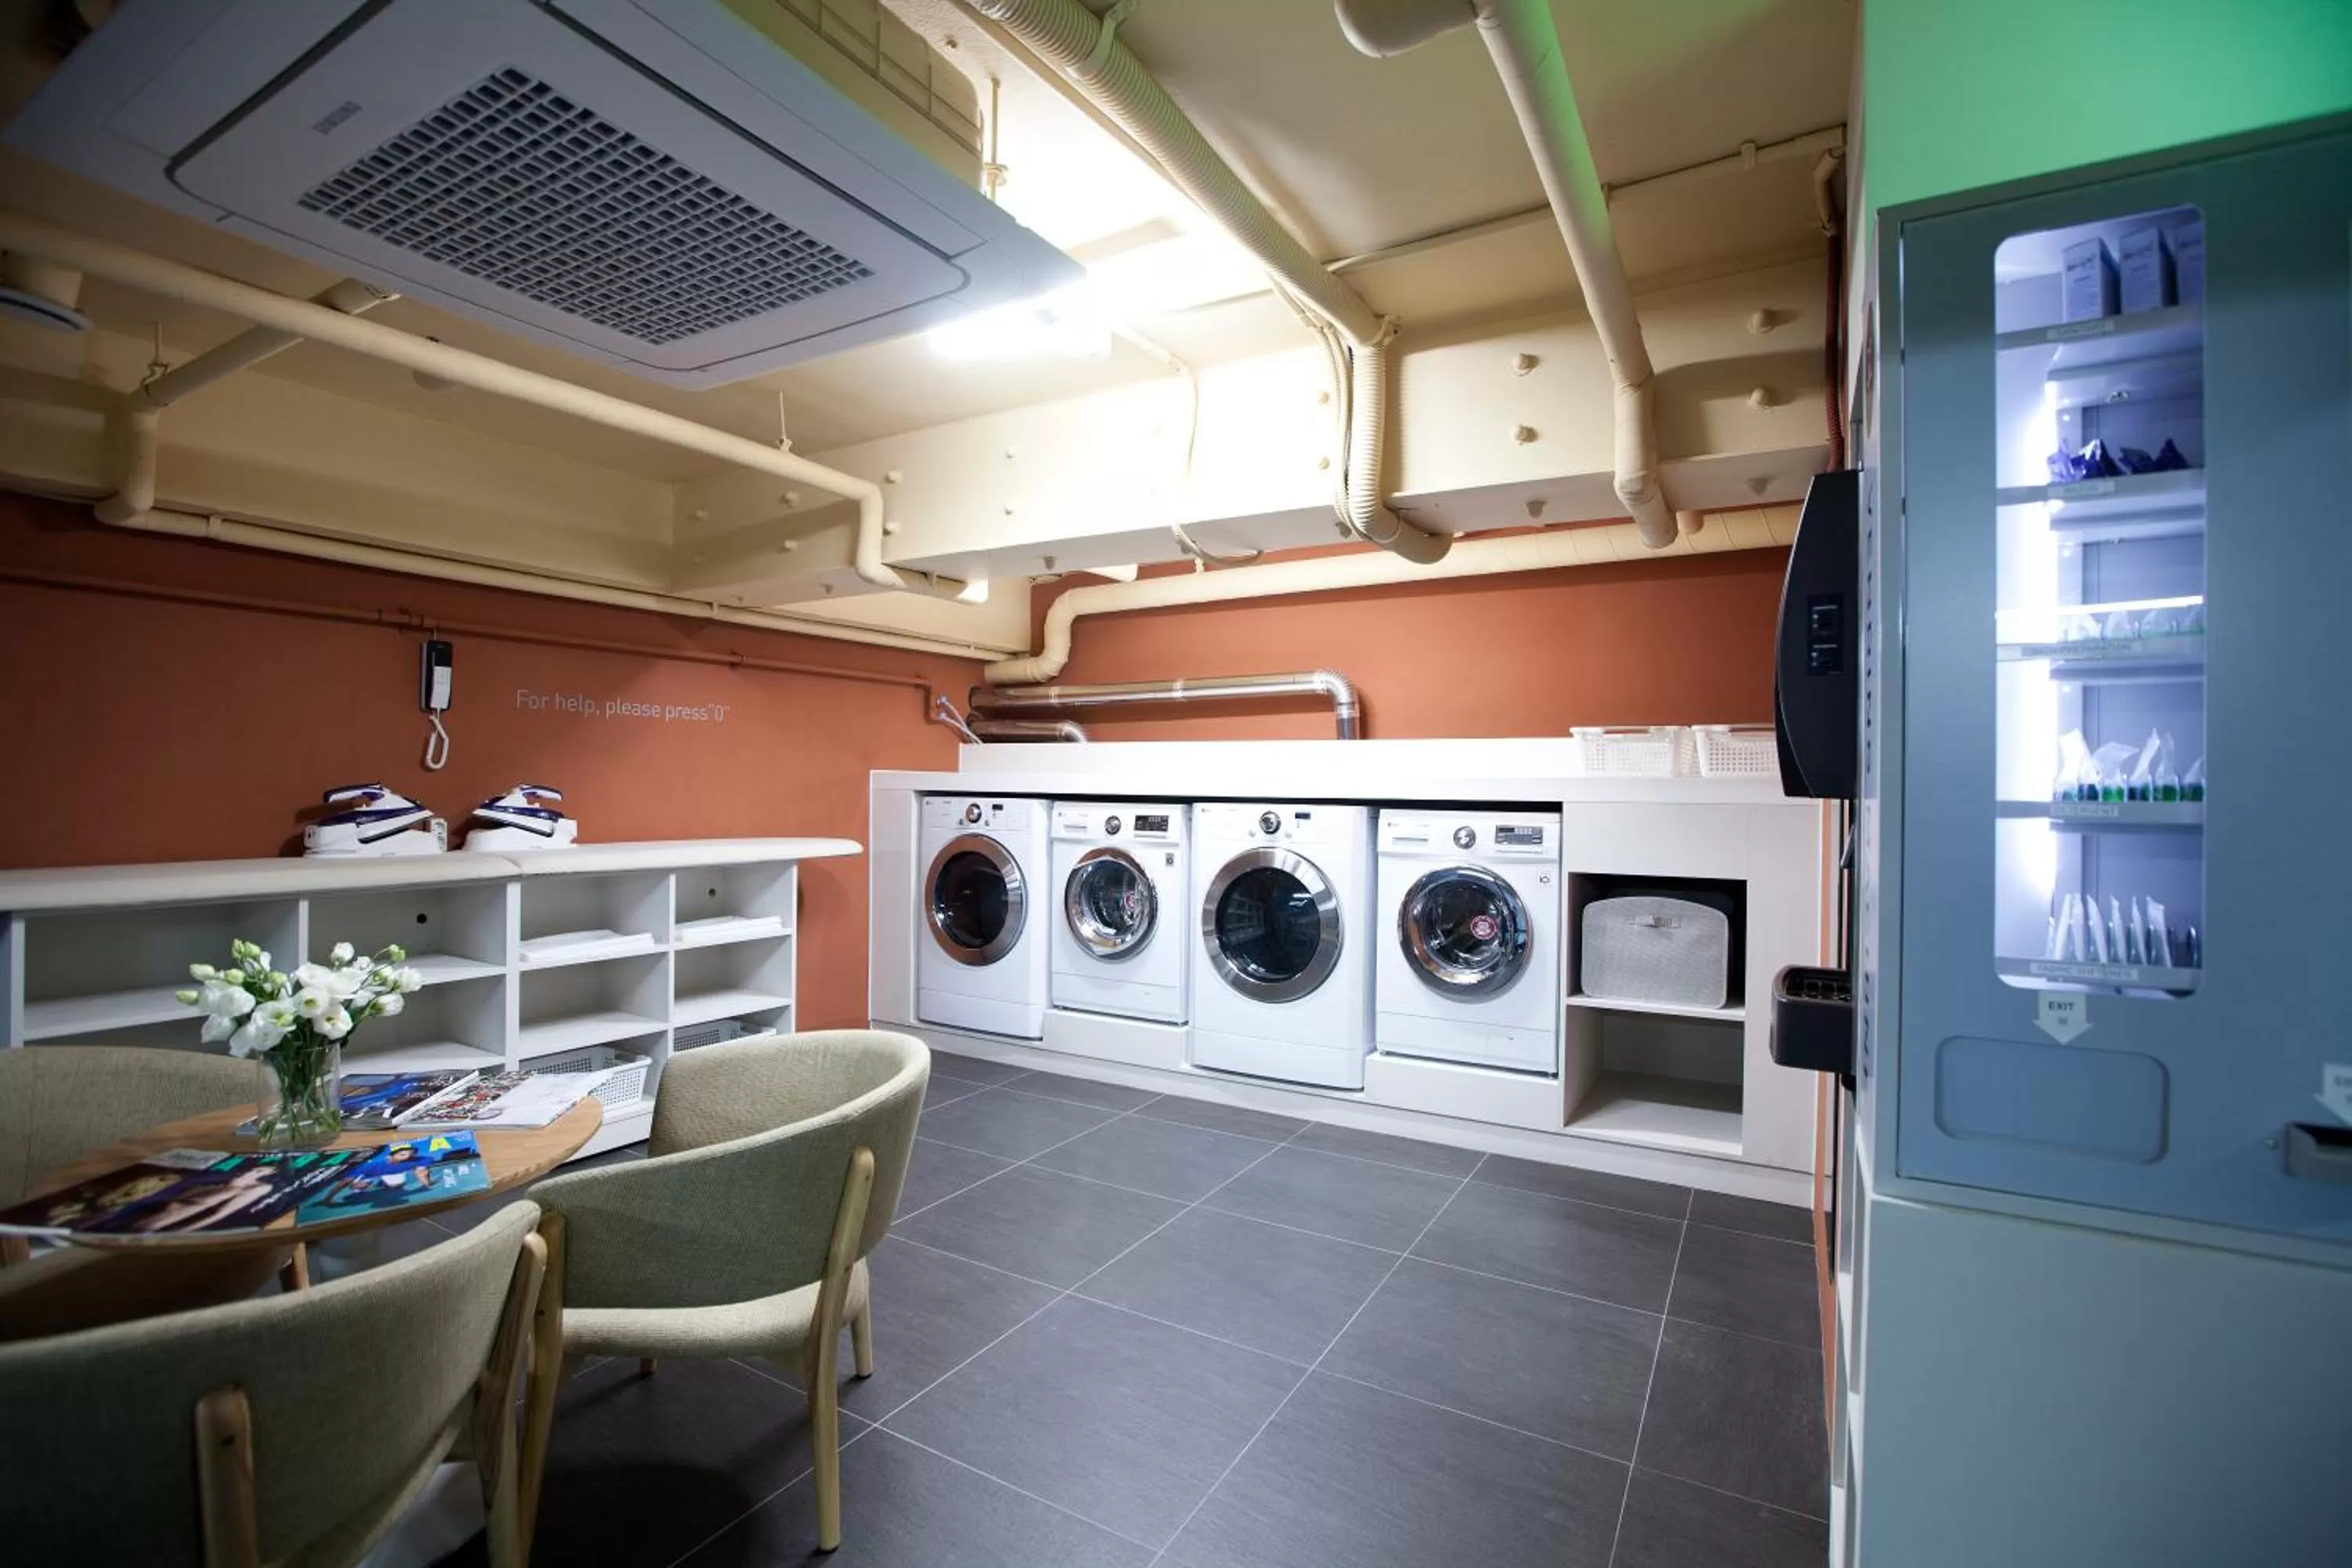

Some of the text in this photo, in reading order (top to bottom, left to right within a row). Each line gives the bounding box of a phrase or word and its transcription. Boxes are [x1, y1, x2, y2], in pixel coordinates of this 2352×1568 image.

[517, 689, 549, 710] For
[555, 691, 601, 717] help,
[606, 696, 661, 720] please
[2048, 1000, 2074, 1011] EXIT
